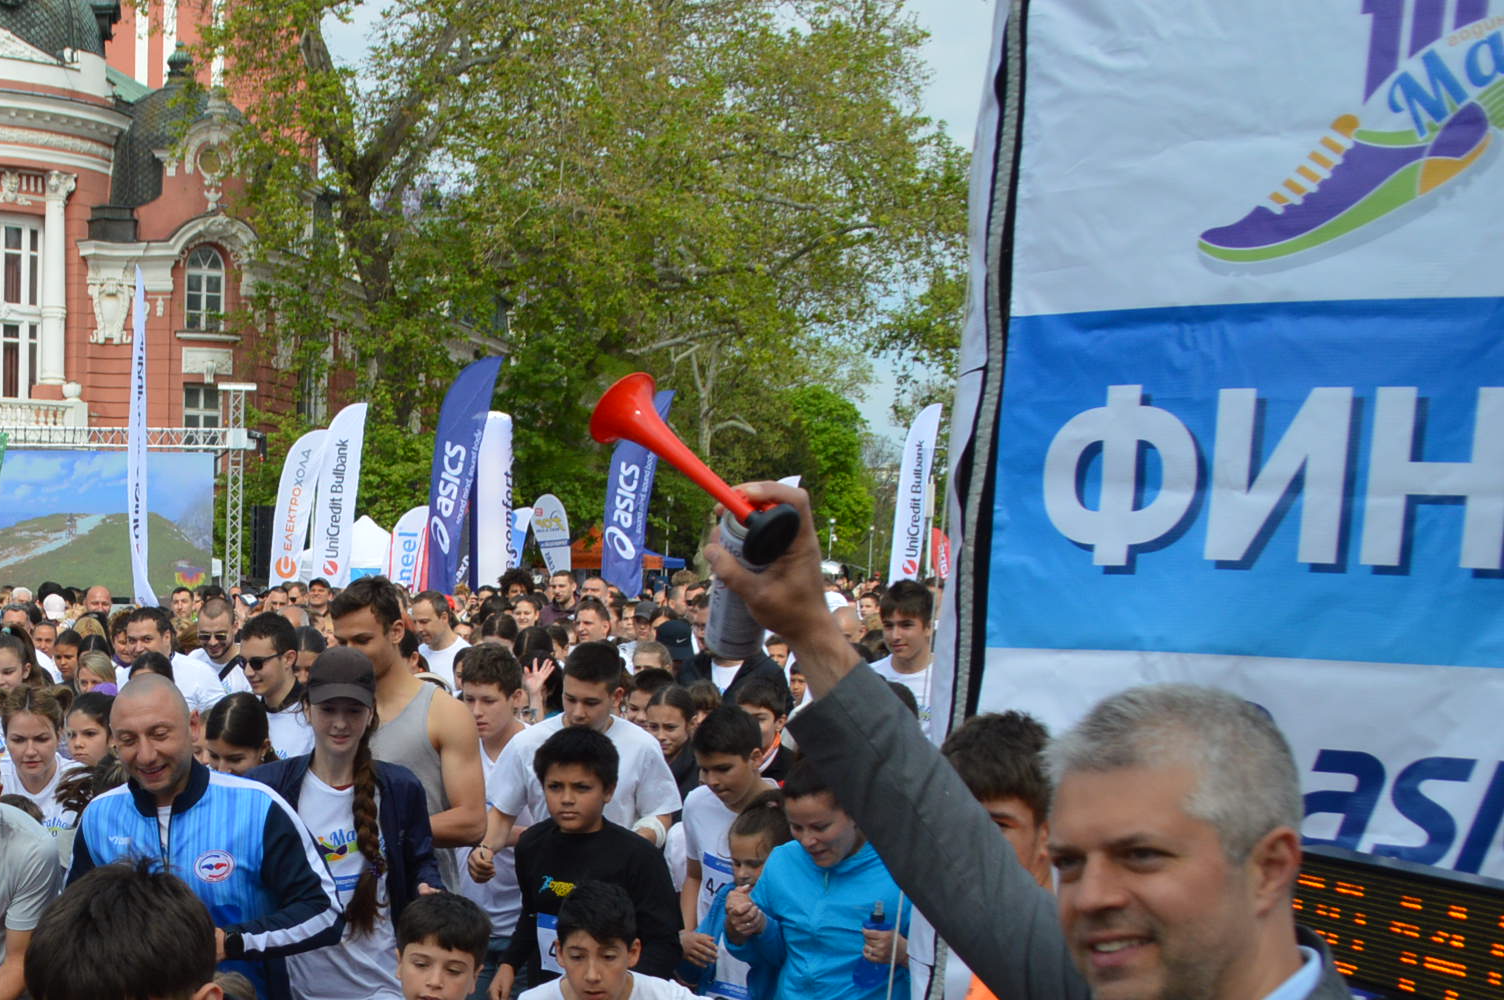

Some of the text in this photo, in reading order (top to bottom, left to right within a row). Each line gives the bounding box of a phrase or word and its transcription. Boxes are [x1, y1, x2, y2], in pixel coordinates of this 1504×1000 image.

[325, 438, 349, 558] UniCredit Bulbank
[905, 440, 925, 558] UniCredit Bulbank
